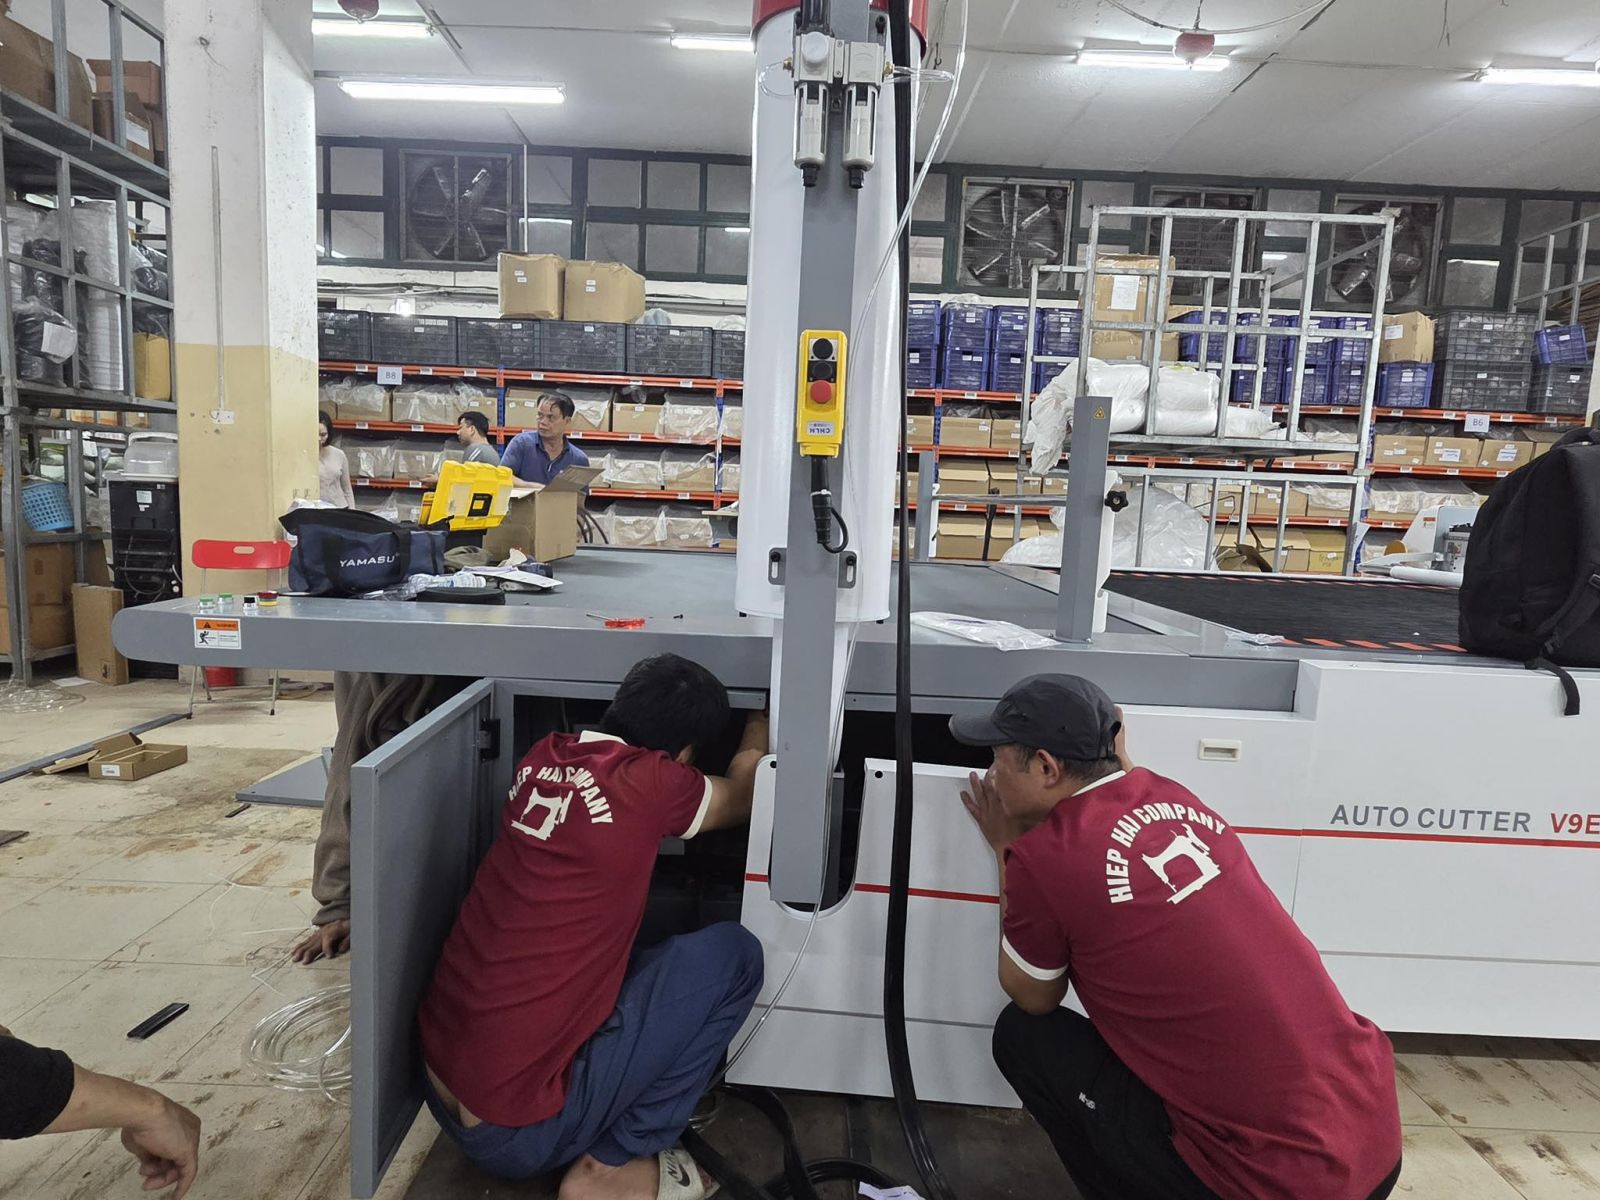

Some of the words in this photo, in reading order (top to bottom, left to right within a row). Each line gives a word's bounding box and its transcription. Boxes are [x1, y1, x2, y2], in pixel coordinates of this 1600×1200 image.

[340, 555, 395, 568] YAMASU
[1110, 814, 1142, 849] HAI
[1132, 802, 1226, 835] COMPANY
[1330, 804, 1409, 828] AUTO
[1417, 808, 1531, 833] CUTTER
[1550, 812, 1600, 835] V9E
[1106, 848, 1134, 904] HIEP
